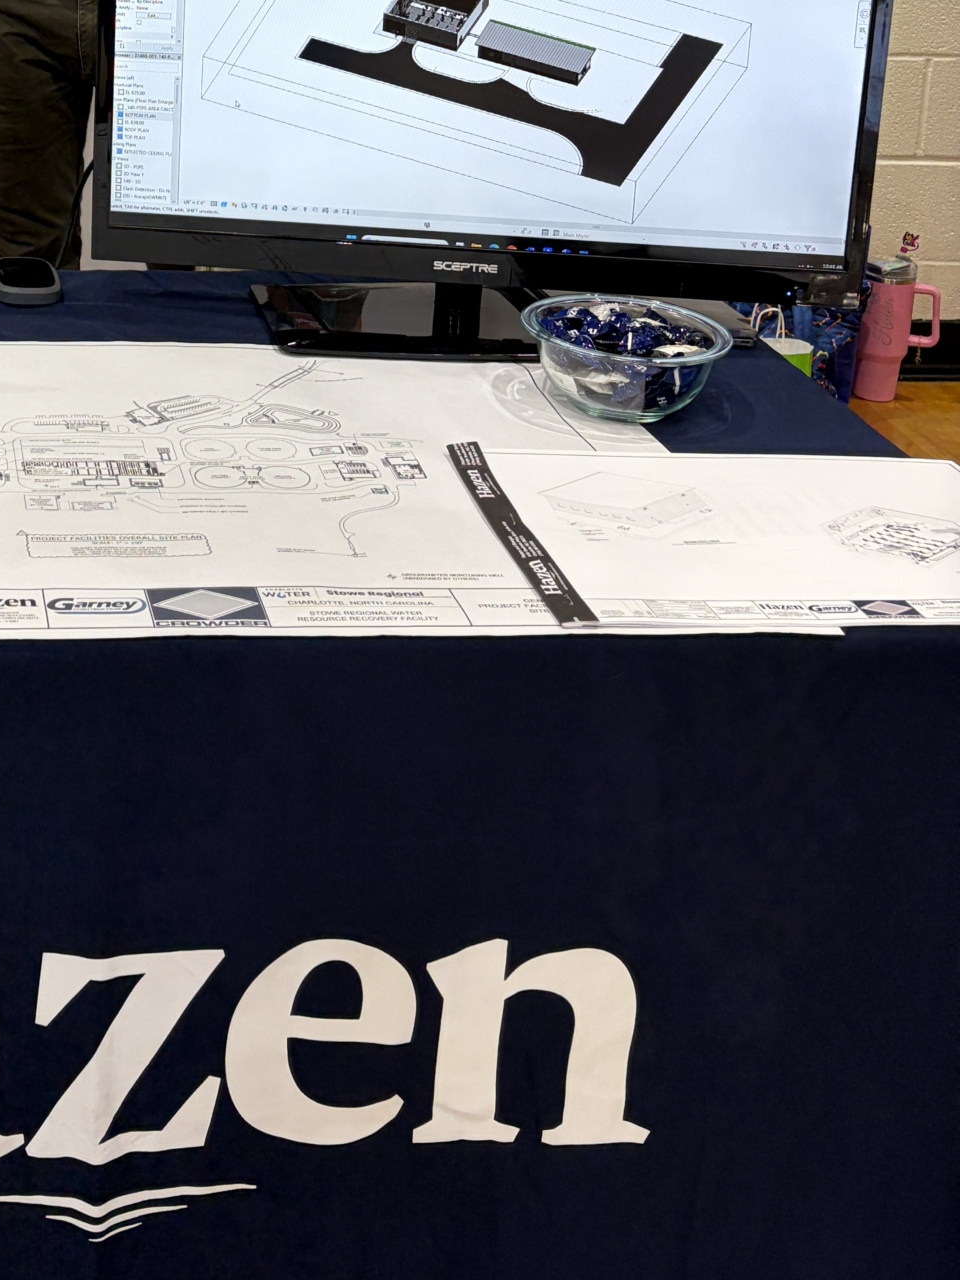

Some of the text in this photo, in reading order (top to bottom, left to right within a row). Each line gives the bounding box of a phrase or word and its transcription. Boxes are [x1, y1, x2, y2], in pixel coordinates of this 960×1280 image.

[433, 261, 498, 274] SCEPTRE
[467, 470, 495, 498] Hazen
[529, 559, 562, 595] Hazen
[47, 598, 138, 611] Garney
